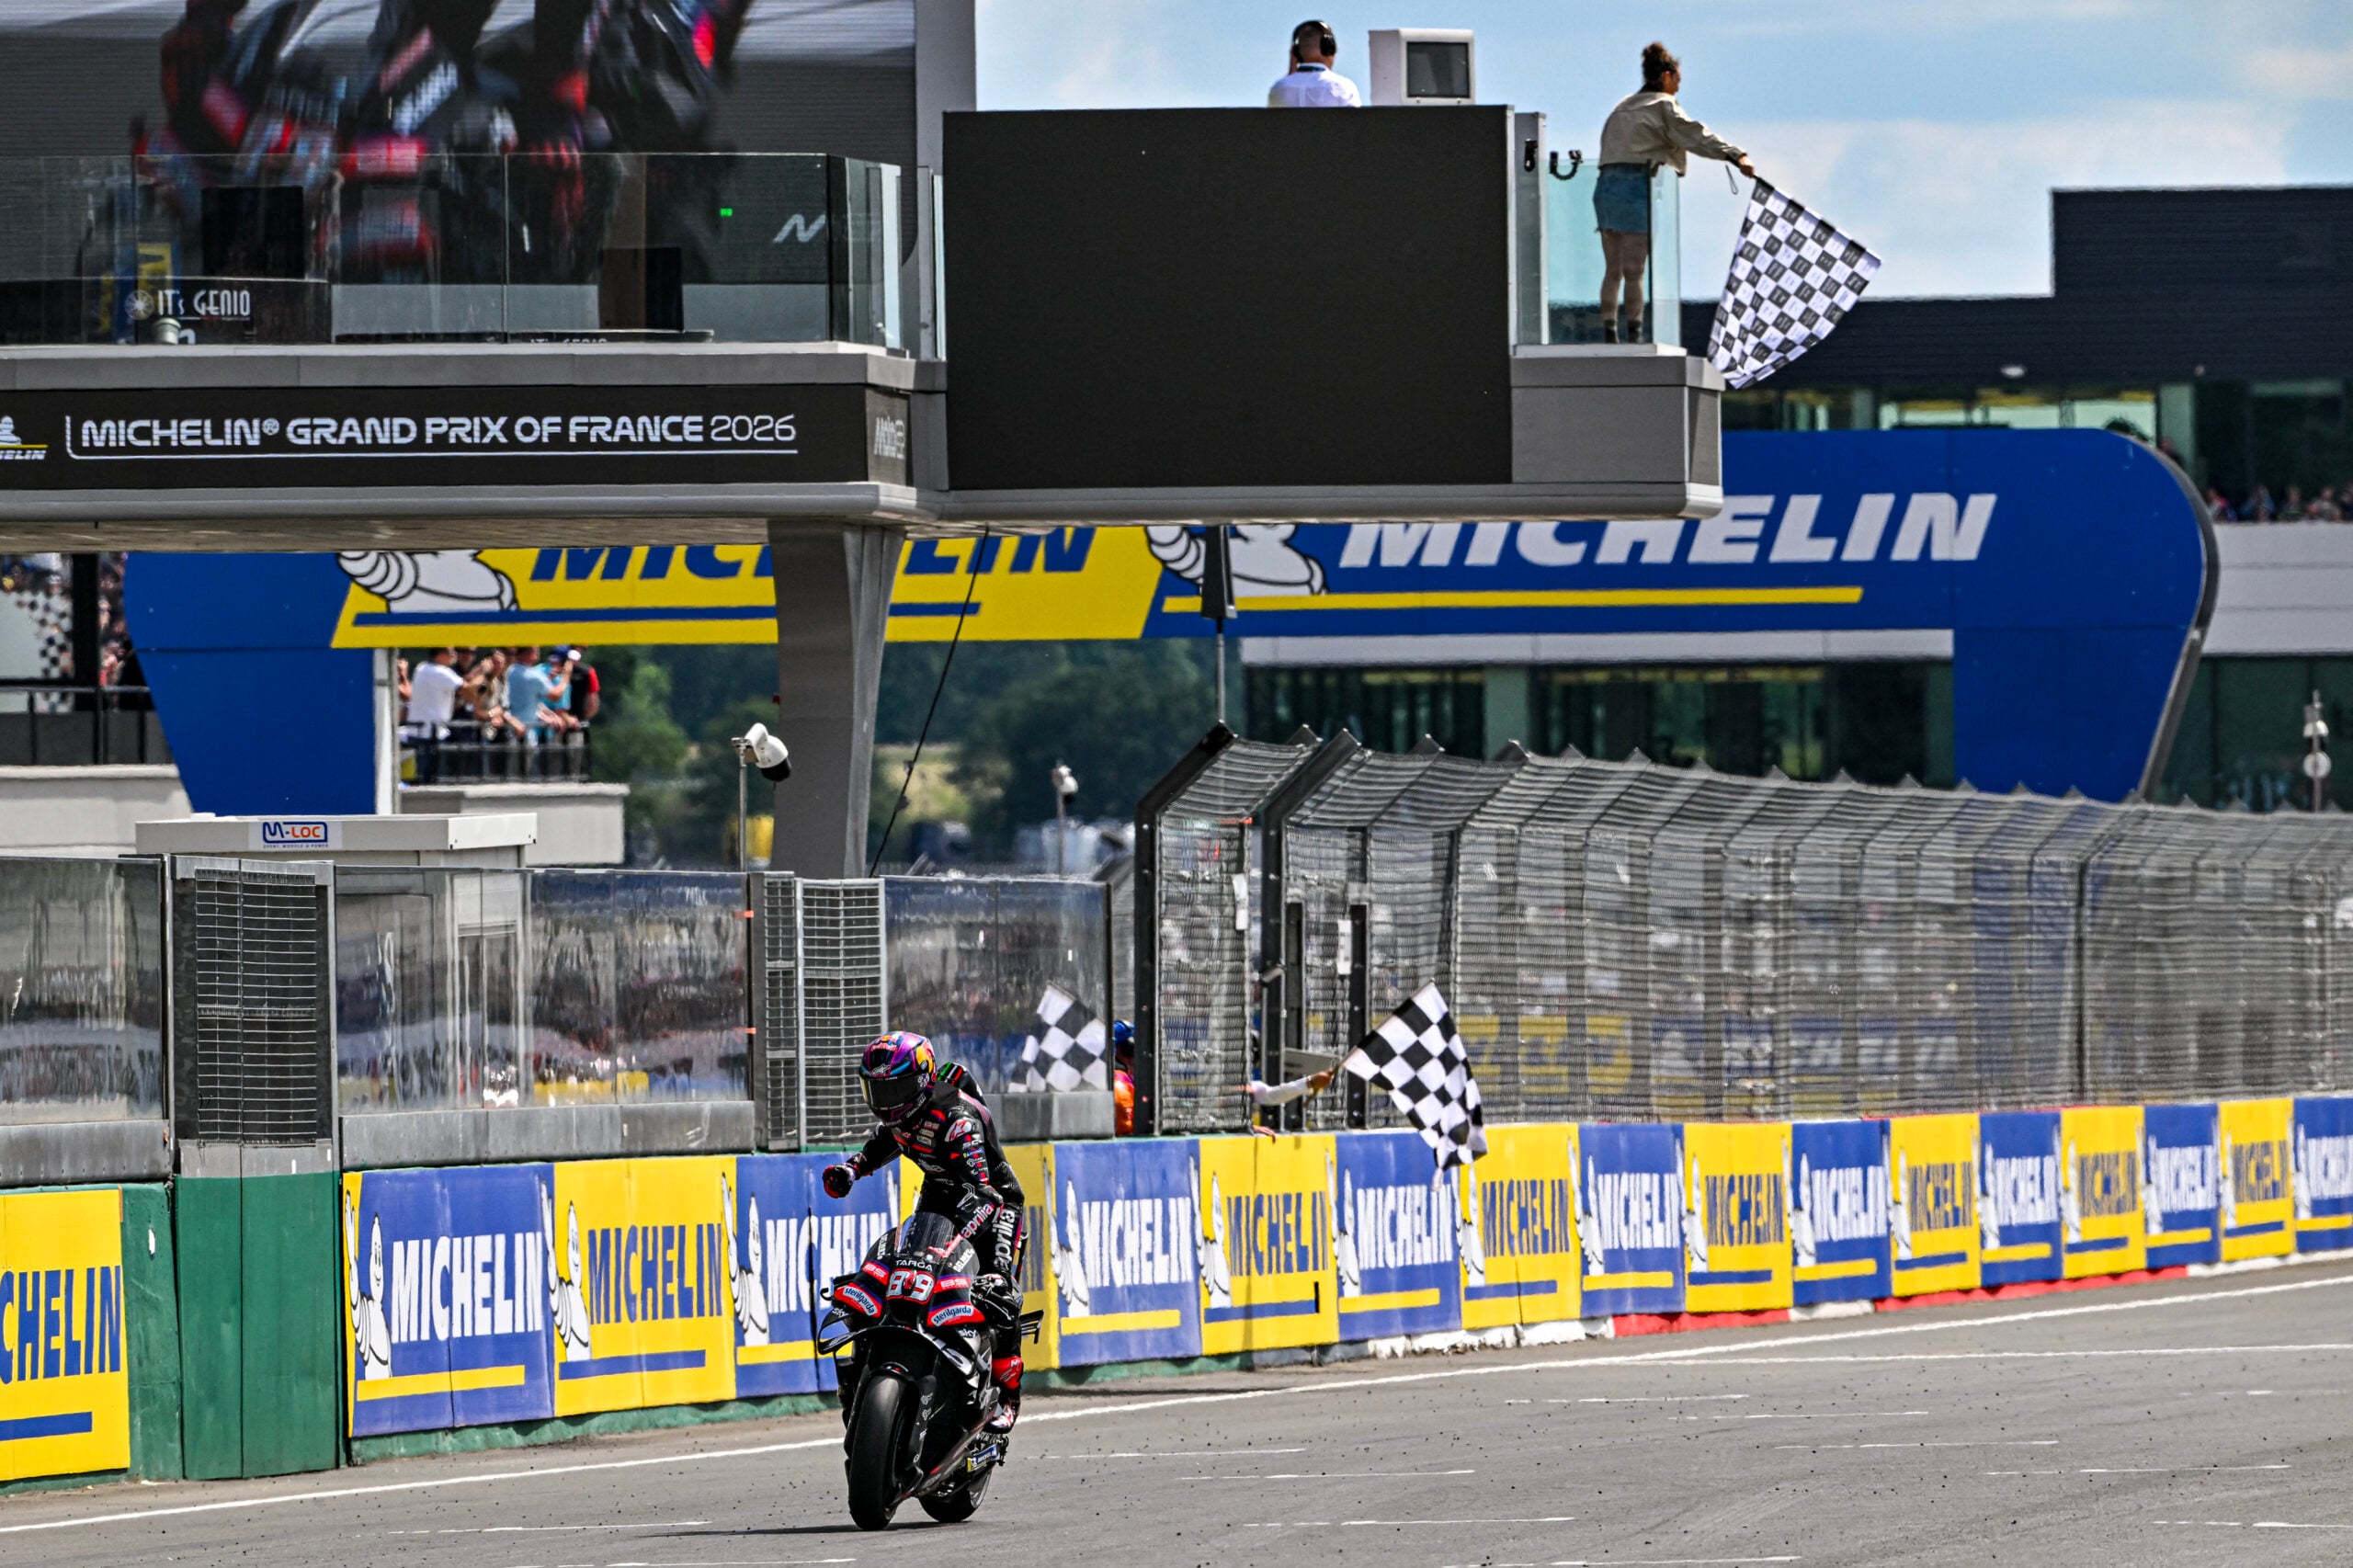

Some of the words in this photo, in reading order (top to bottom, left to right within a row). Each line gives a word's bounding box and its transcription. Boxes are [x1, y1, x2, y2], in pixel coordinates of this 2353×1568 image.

[193, 290, 251, 316] GENIO
[286, 417, 417, 446] GRAND
[425, 416, 508, 444] PRIX
[514, 416, 562, 443] OF
[568, 415, 704, 443] FRANCE
[710, 414, 797, 442] 2026
[1338, 493, 1998, 568] MICHELIN
[961, 1203, 995, 1239] aprilia
[1082, 1197, 1192, 1287] MICHELIN
[1227, 1191, 1328, 1277] MICHELIN
[1357, 1184, 1452, 1270] MICHELIN
[1483, 1178, 1570, 1256] MICHELIN
[1598, 1172, 1680, 1250] MICHELIN
[392, 1232, 542, 1344] MICHELIN
[587, 1223, 722, 1324] MICHELIN
[844, 1288, 876, 1314] sterilgarda
[886, 1270, 935, 1301] 89
[933, 1305, 972, 1324] sterilgarda
